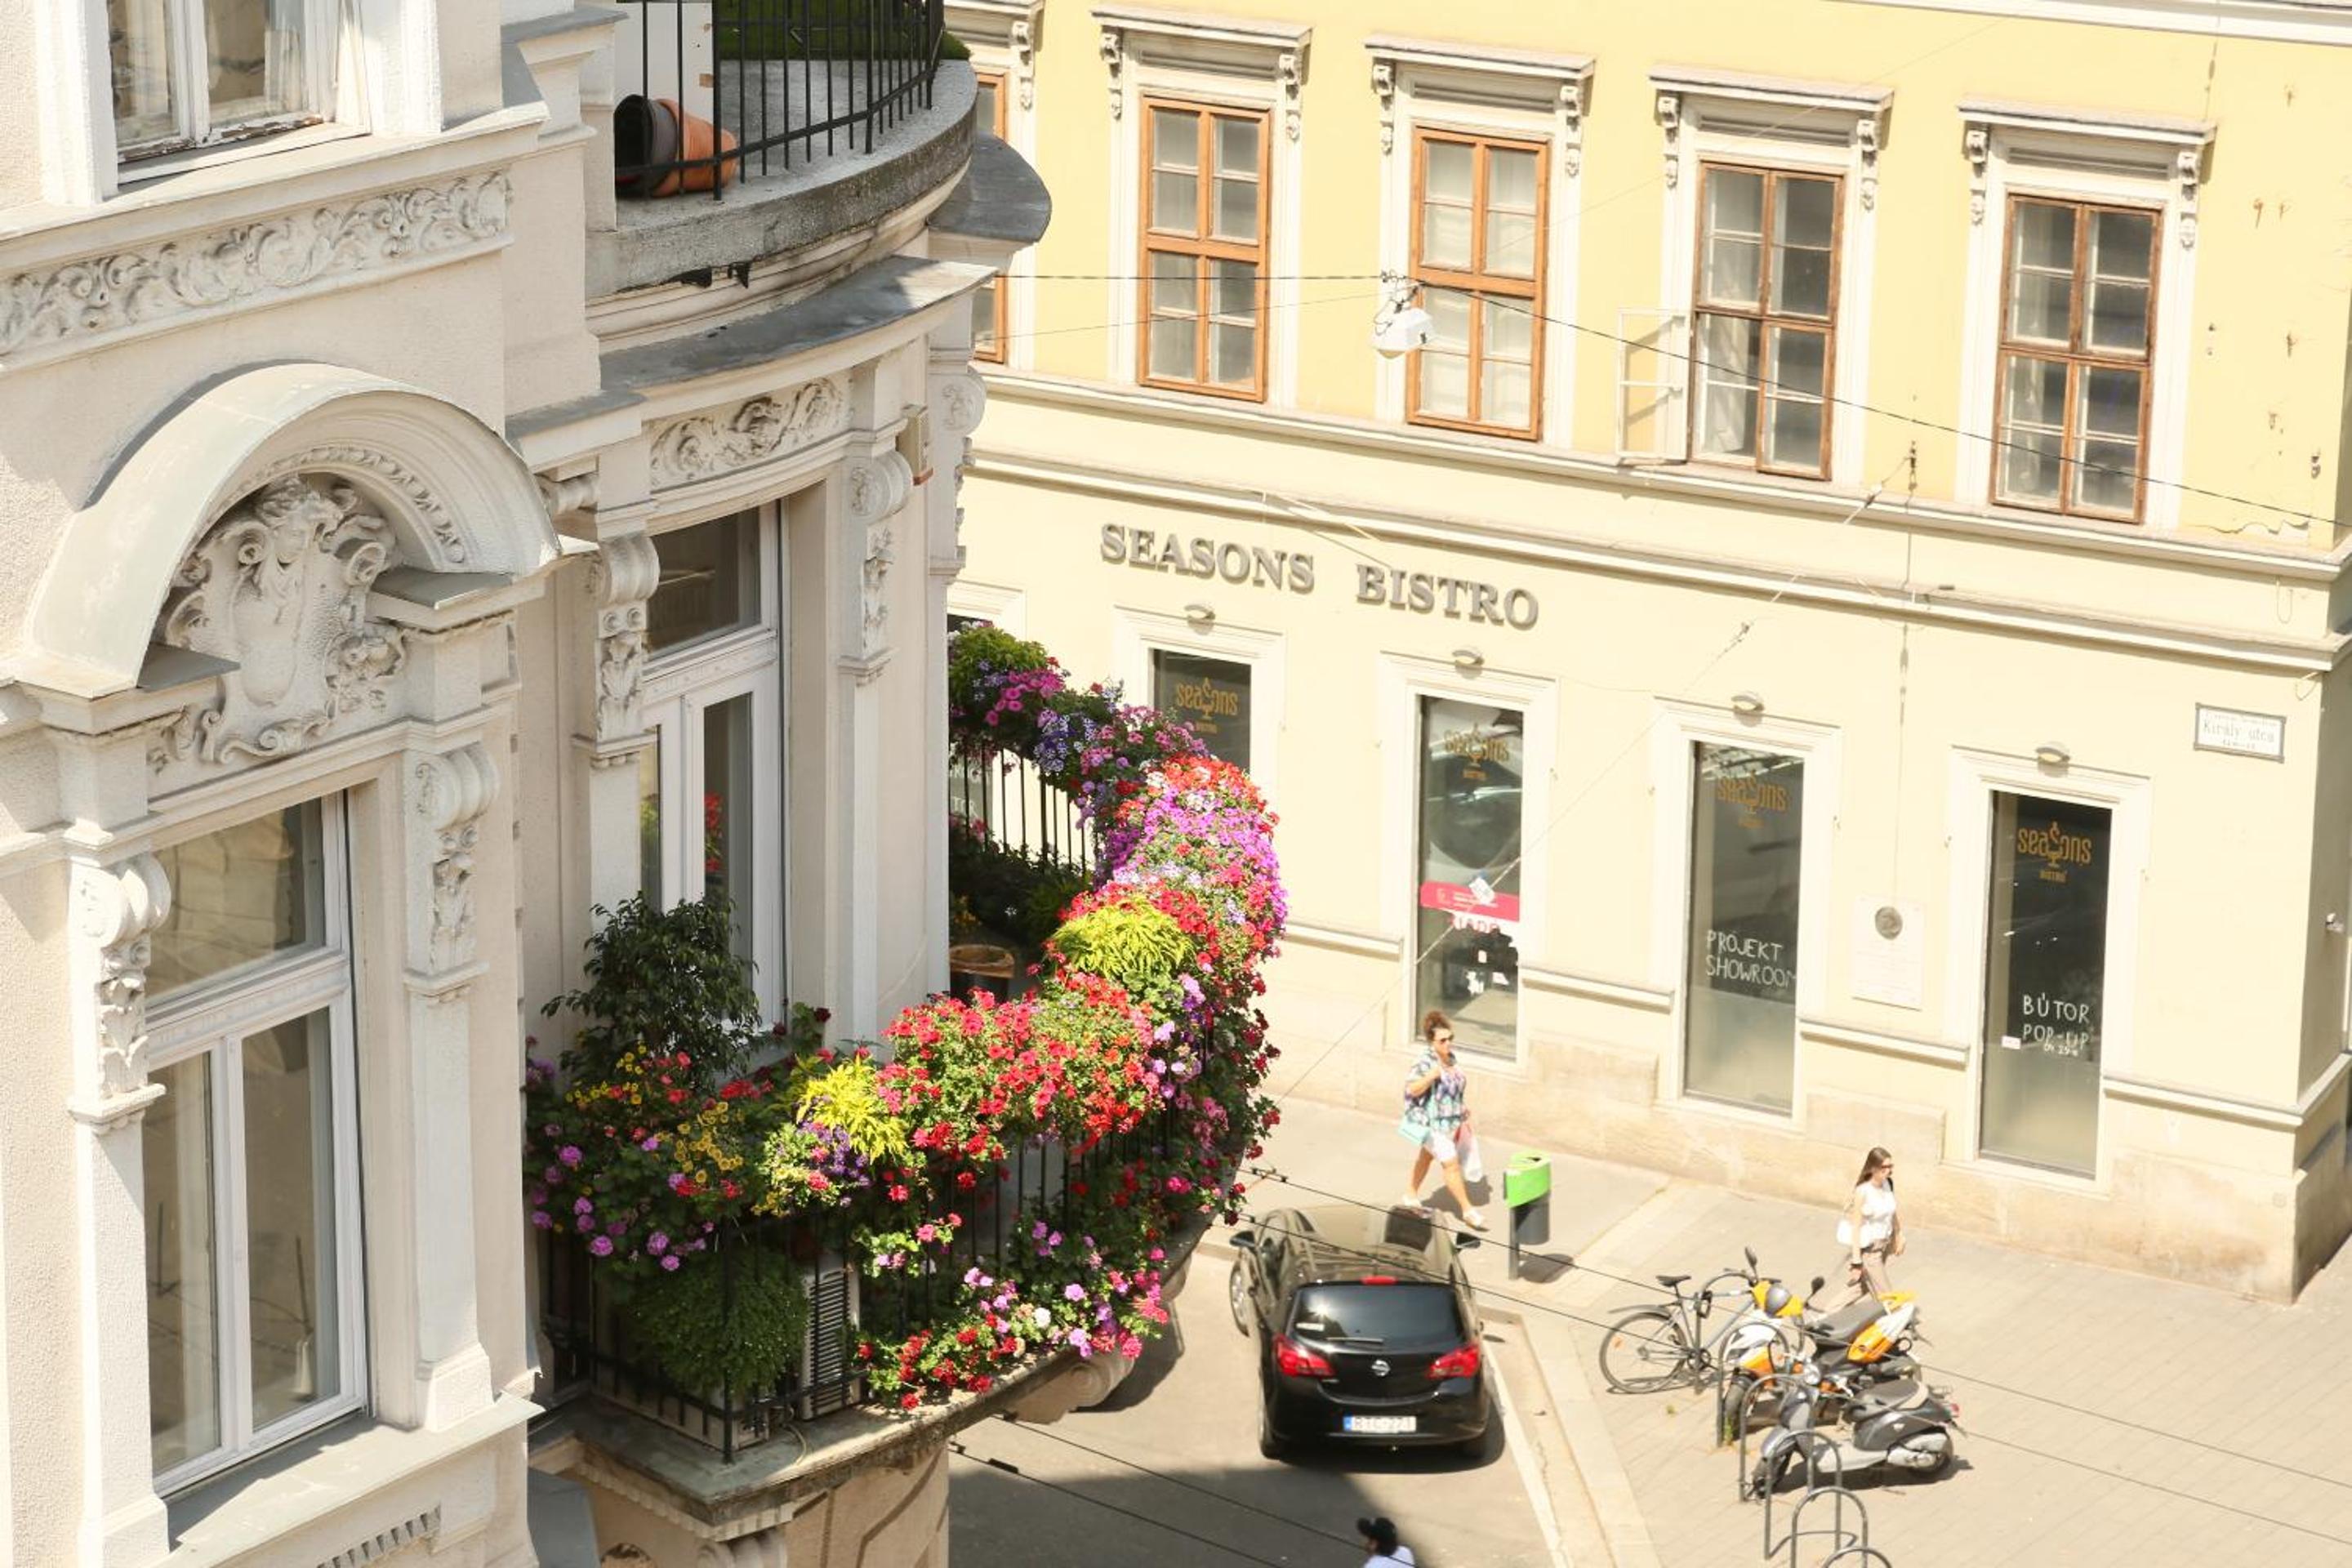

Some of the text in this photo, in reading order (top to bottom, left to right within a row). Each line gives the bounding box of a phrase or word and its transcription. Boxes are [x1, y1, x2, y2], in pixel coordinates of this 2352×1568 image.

[1101, 523, 1539, 631] SEASONS BISTRO
[1706, 929, 1784, 962] PROJEKT
[2022, 992, 2091, 1024] BÚTOR
[2022, 1023, 2090, 1050] POP-UP
